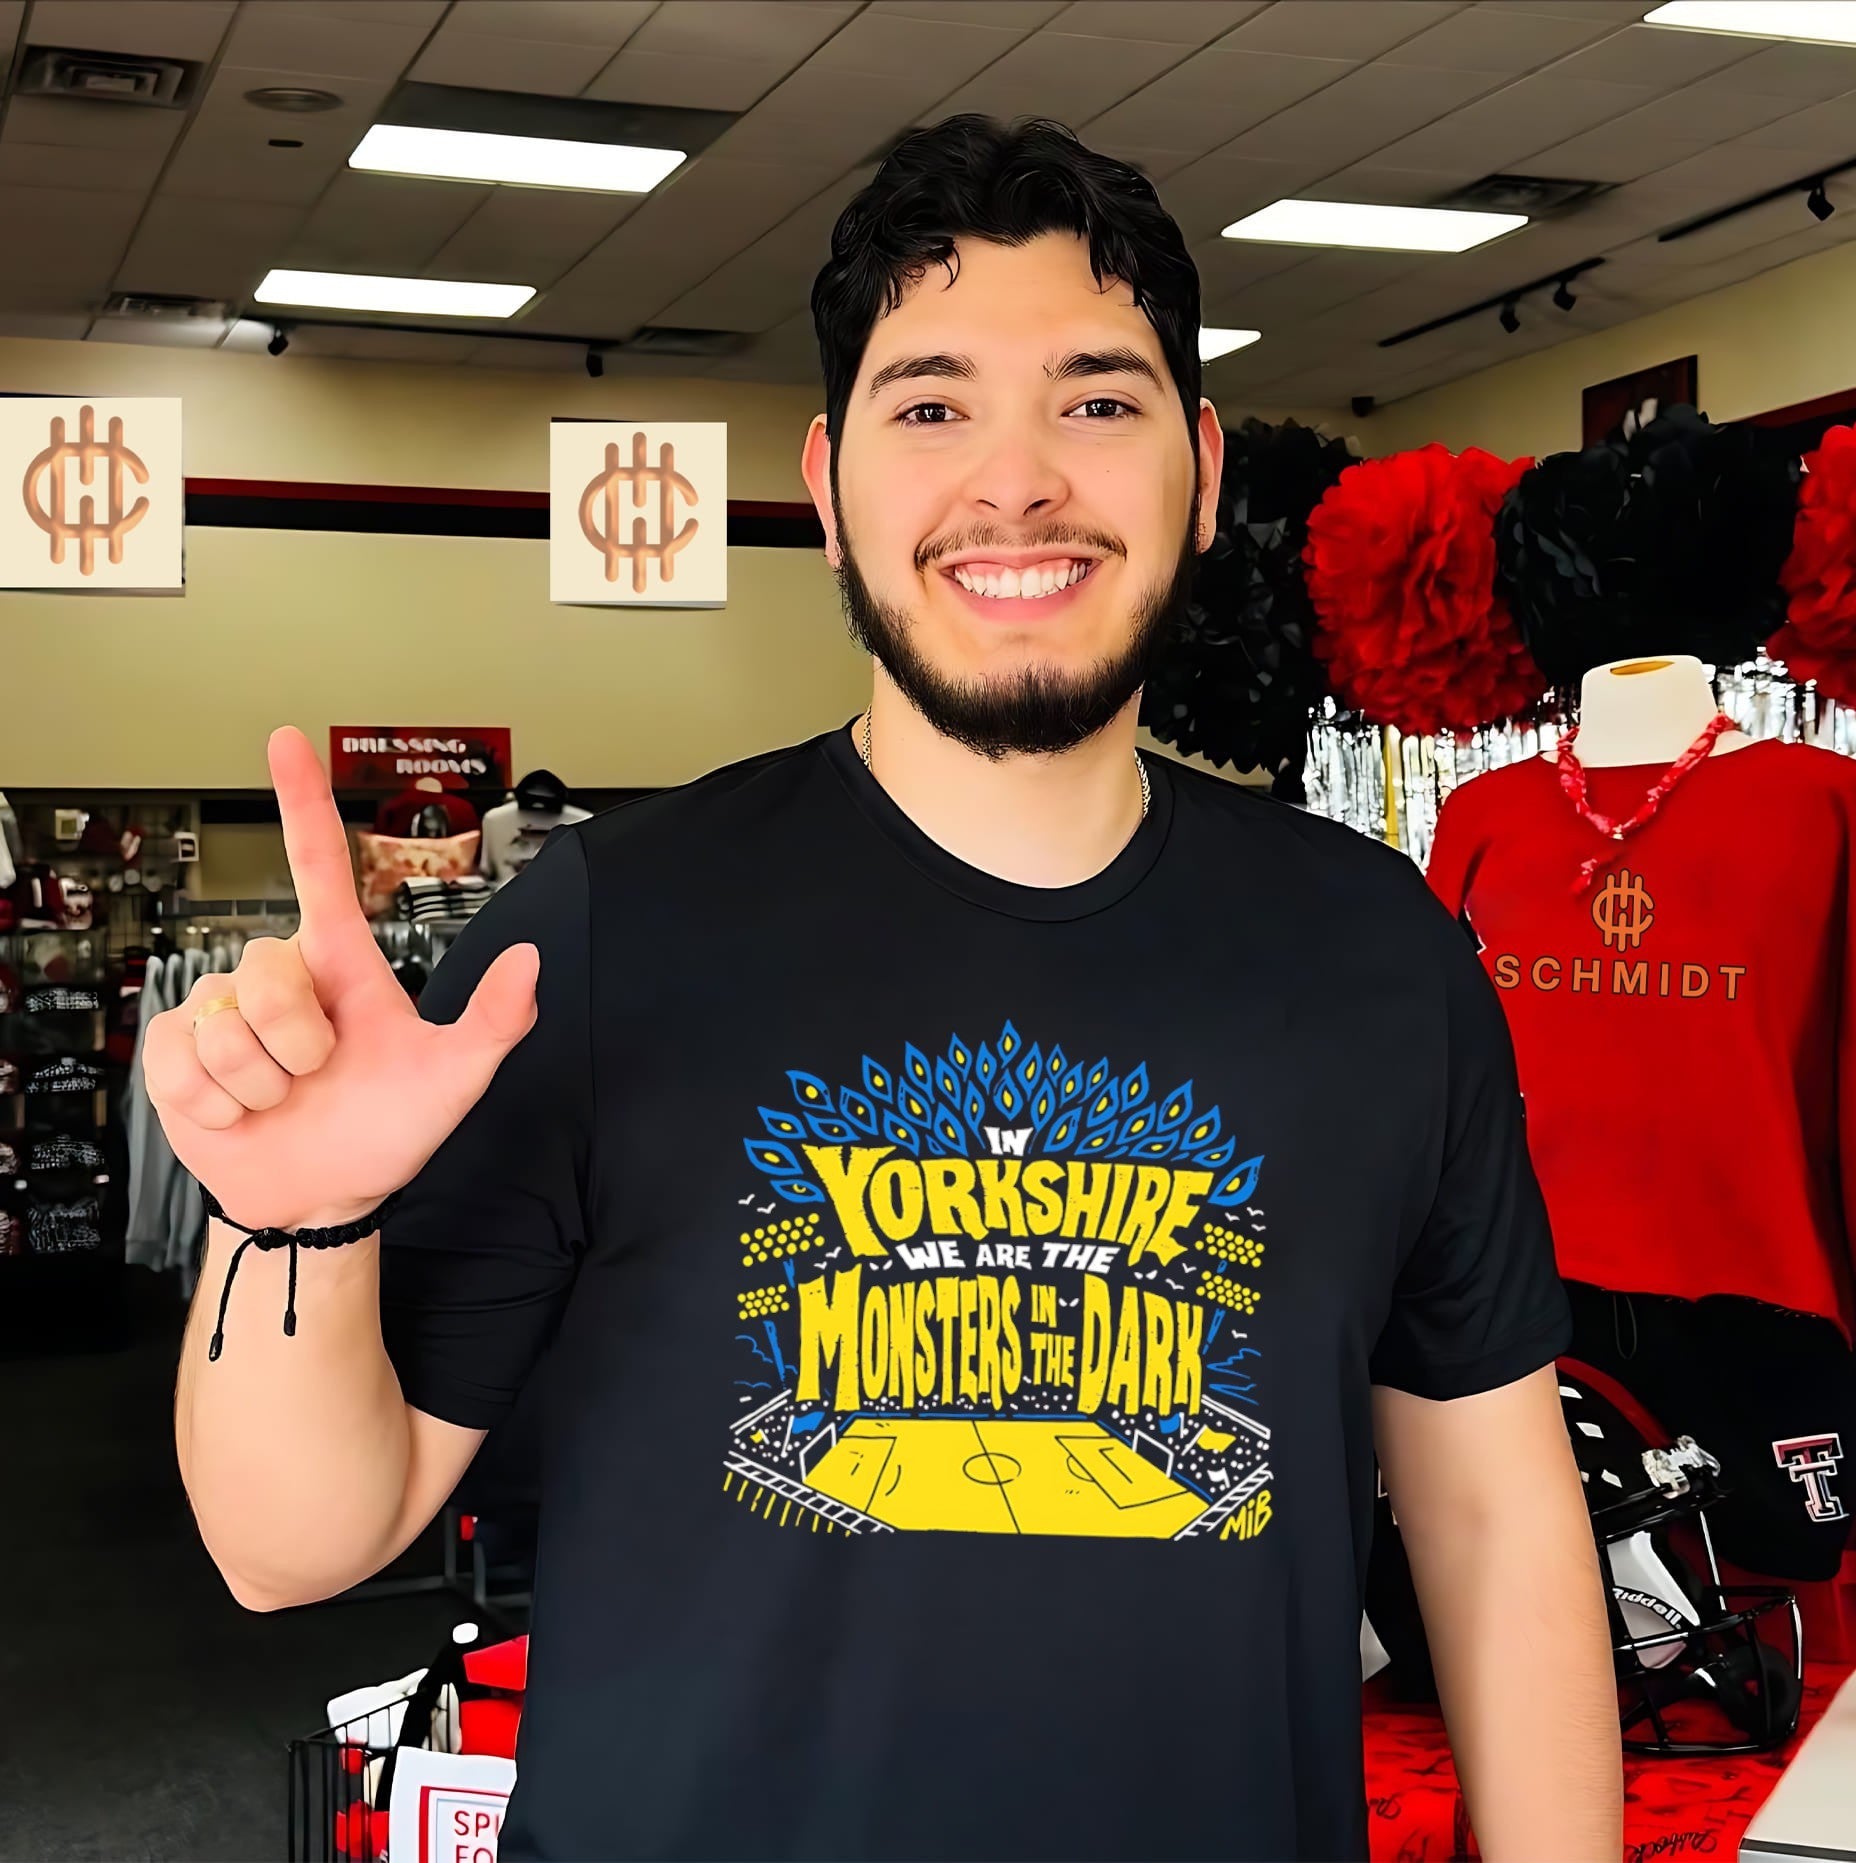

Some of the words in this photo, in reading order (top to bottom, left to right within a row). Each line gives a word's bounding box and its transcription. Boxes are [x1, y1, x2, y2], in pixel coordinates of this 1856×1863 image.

[342, 737, 466, 754] DRESSING
[396, 759, 487, 775] ROOMS
[1494, 955, 1747, 1000] SCHMIDT
[985, 1126, 1033, 1156] IN
[802, 1144, 1214, 1268] YORKSHIRE
[896, 1240, 966, 1270] WE
[975, 1243, 1032, 1270] ARE
[1041, 1242, 1120, 1274] THE
[1031, 1284, 1057, 1328] IN
[795, 1263, 1022, 1412] MONSTERS
[1078, 1273, 1204, 1416] DARK
[1030, 1332, 1076, 1388] THE
